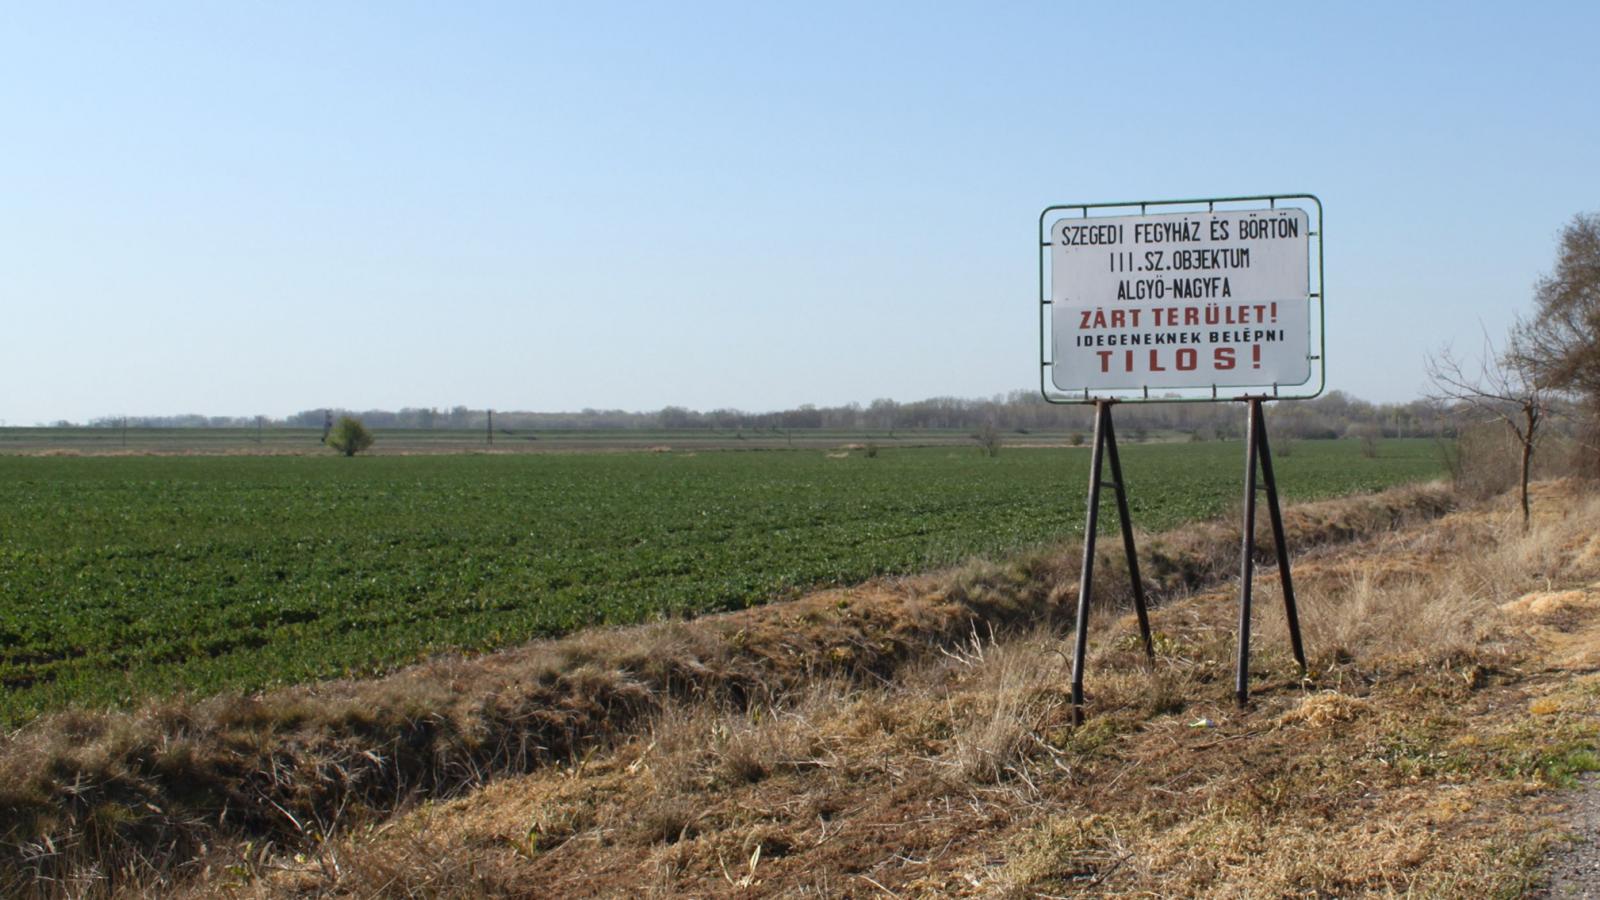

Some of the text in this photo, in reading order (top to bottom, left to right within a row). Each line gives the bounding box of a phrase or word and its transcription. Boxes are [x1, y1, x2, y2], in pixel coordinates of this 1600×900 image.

[1061, 212, 1298, 246] SZEGEDI FEGYHÁZ ÉS BÖRTÖN
[1079, 302, 1277, 330] ZÁRT TERÜLET!
[1077, 328, 1284, 347] IDEGENEKNEK BELÉPNI
[1096, 344, 1261, 373] TILOS!
